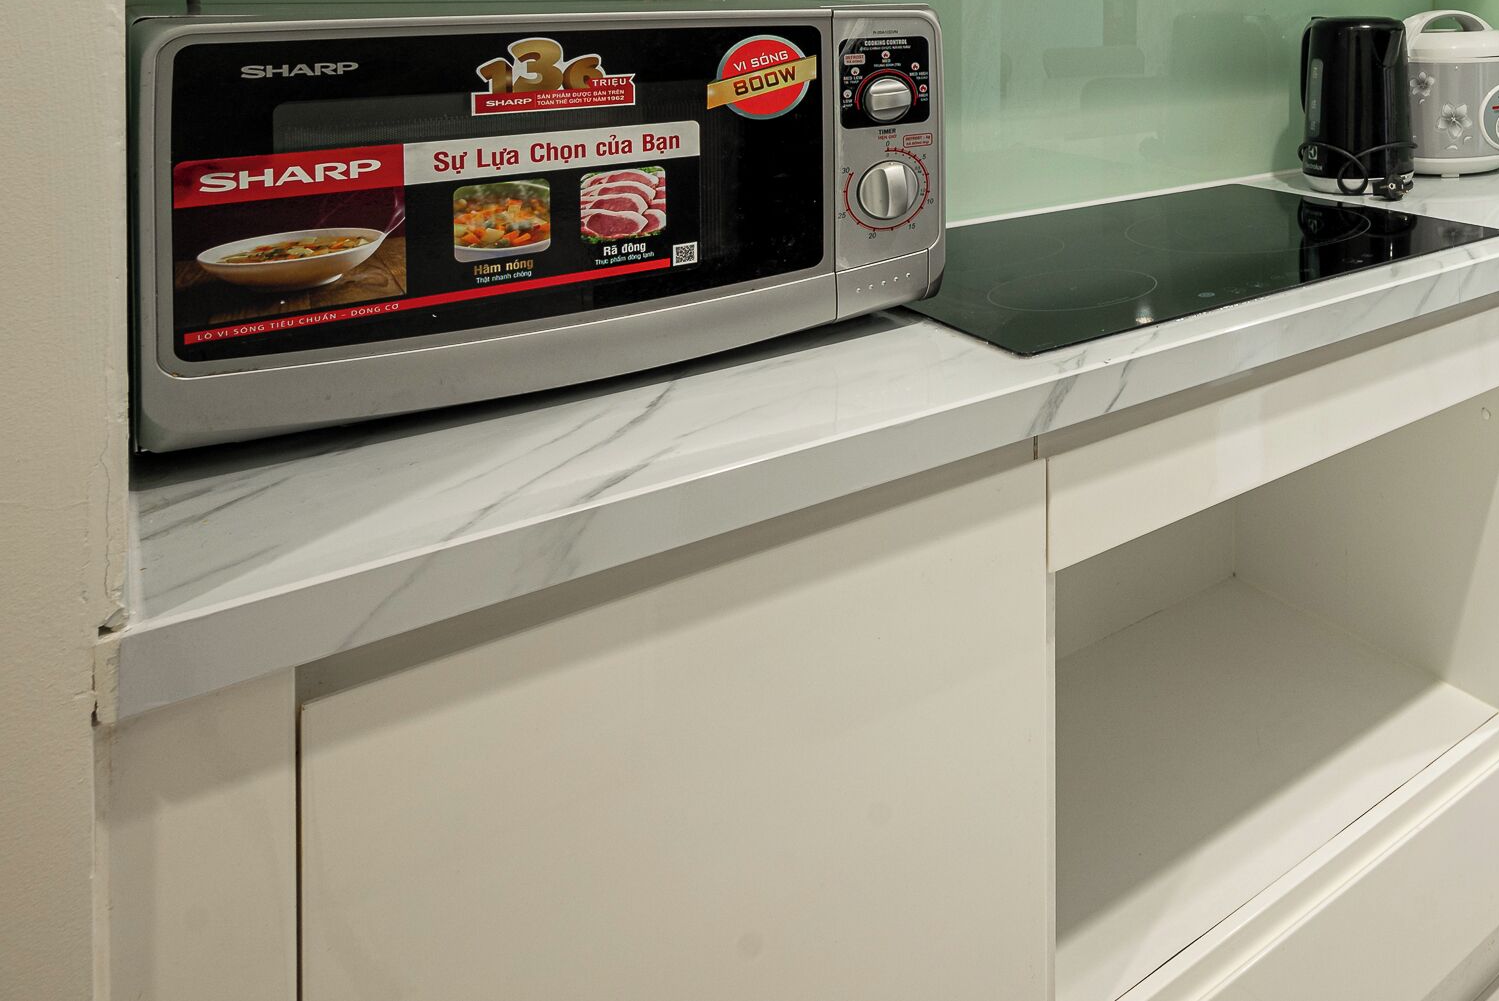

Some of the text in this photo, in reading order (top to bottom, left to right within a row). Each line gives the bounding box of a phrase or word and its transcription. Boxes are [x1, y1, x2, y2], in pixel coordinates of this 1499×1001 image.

[478, 38, 627, 93] 136 TRIỆU
[733, 50, 789, 71] VI SÓNG
[241, 62, 359, 79] SHARP
[733, 66, 796, 96] 800W
[485, 97, 532, 107] SHARP
[433, 133, 680, 174] Sự Lựa Chọn của Bạn
[199, 159, 382, 193] SHARP
[841, 166, 850, 174] 30
[838, 212, 847, 220] 25
[603, 242, 646, 256] Rã đông
[627, 253, 642, 261] đông
[474, 258, 534, 275] Hâm nóng
[492, 273, 512, 281] nhanh
[513, 270, 532, 278] chóng
[233, 324, 265, 335] SÓNG
[270, 319, 294, 329] TIÊU
